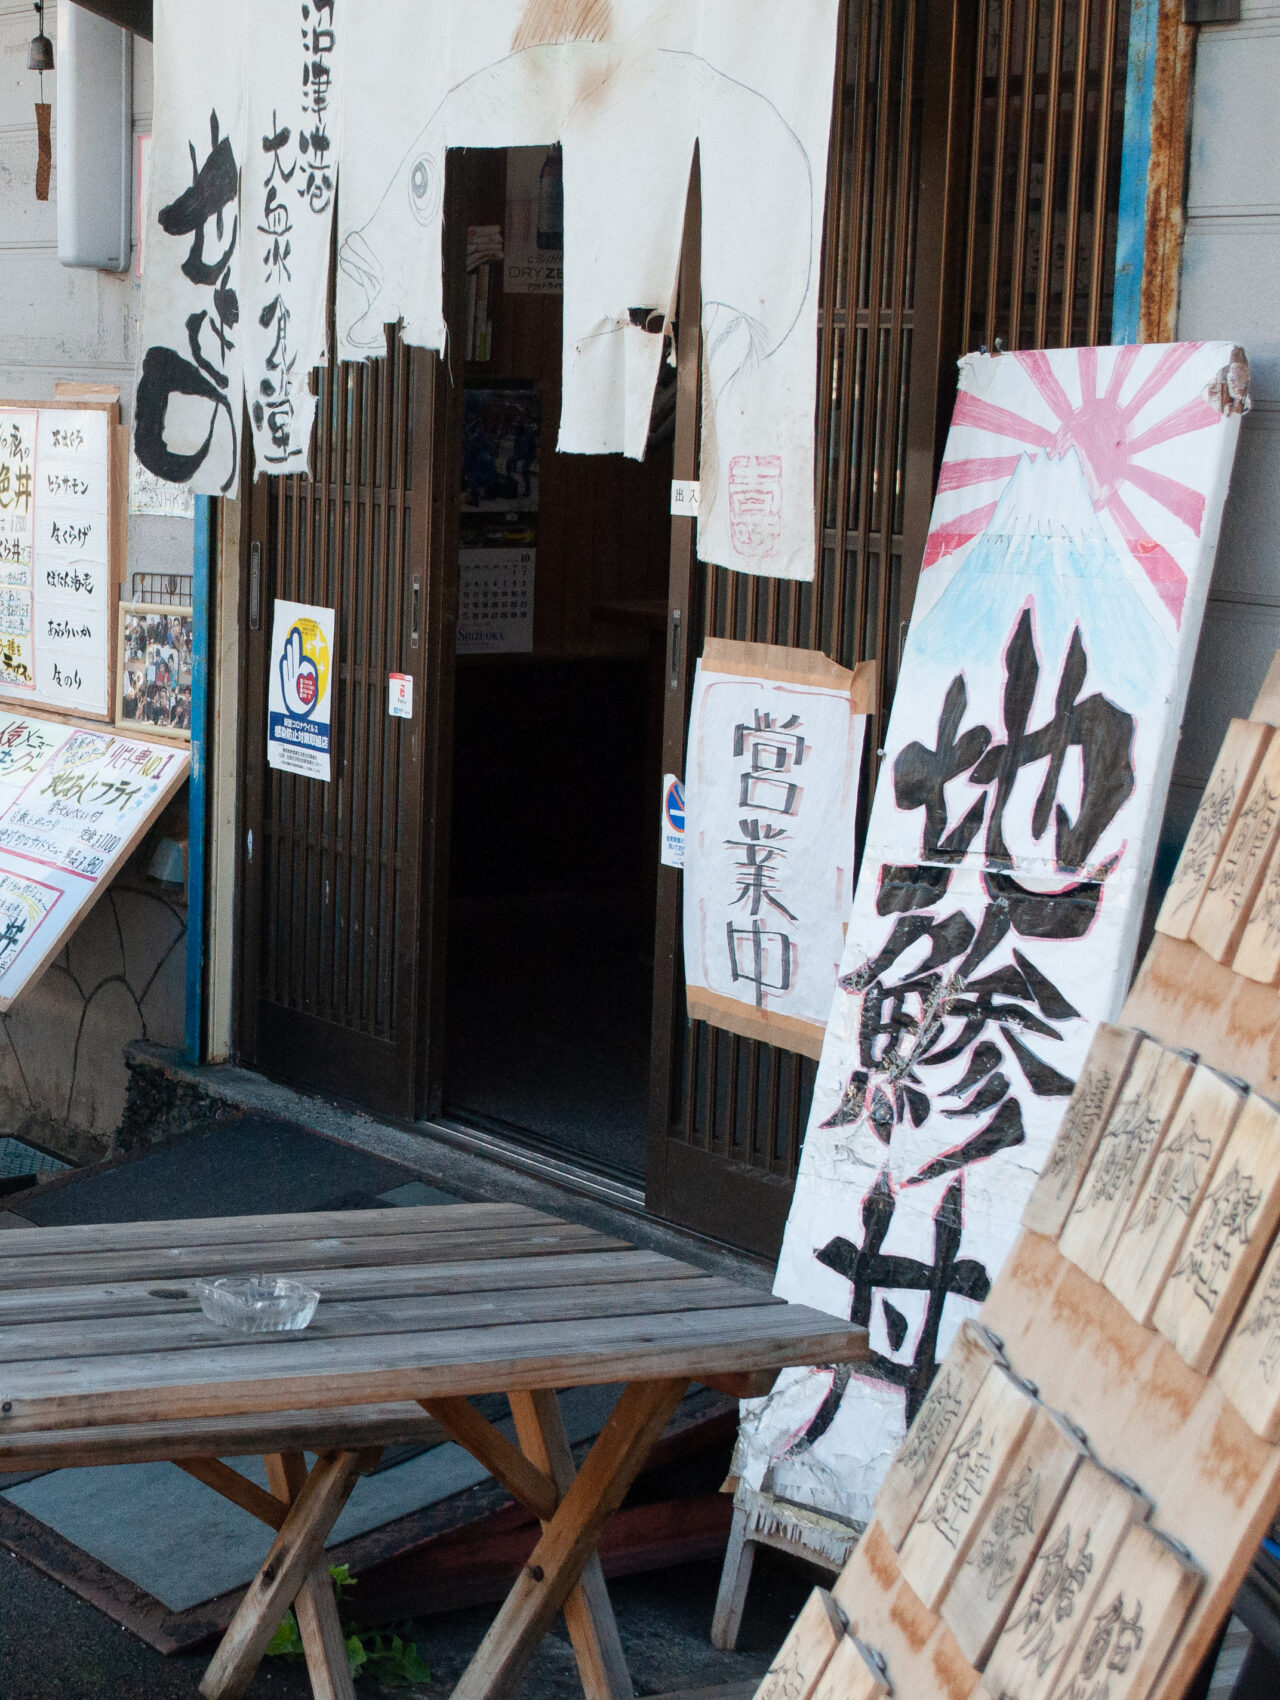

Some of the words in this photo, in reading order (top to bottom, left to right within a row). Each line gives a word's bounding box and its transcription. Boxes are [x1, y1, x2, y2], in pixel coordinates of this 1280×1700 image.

[134, 107, 240, 494] せきの
[52, 663, 83, 690] 生のり
[723, 708, 808, 1012] 営業中
